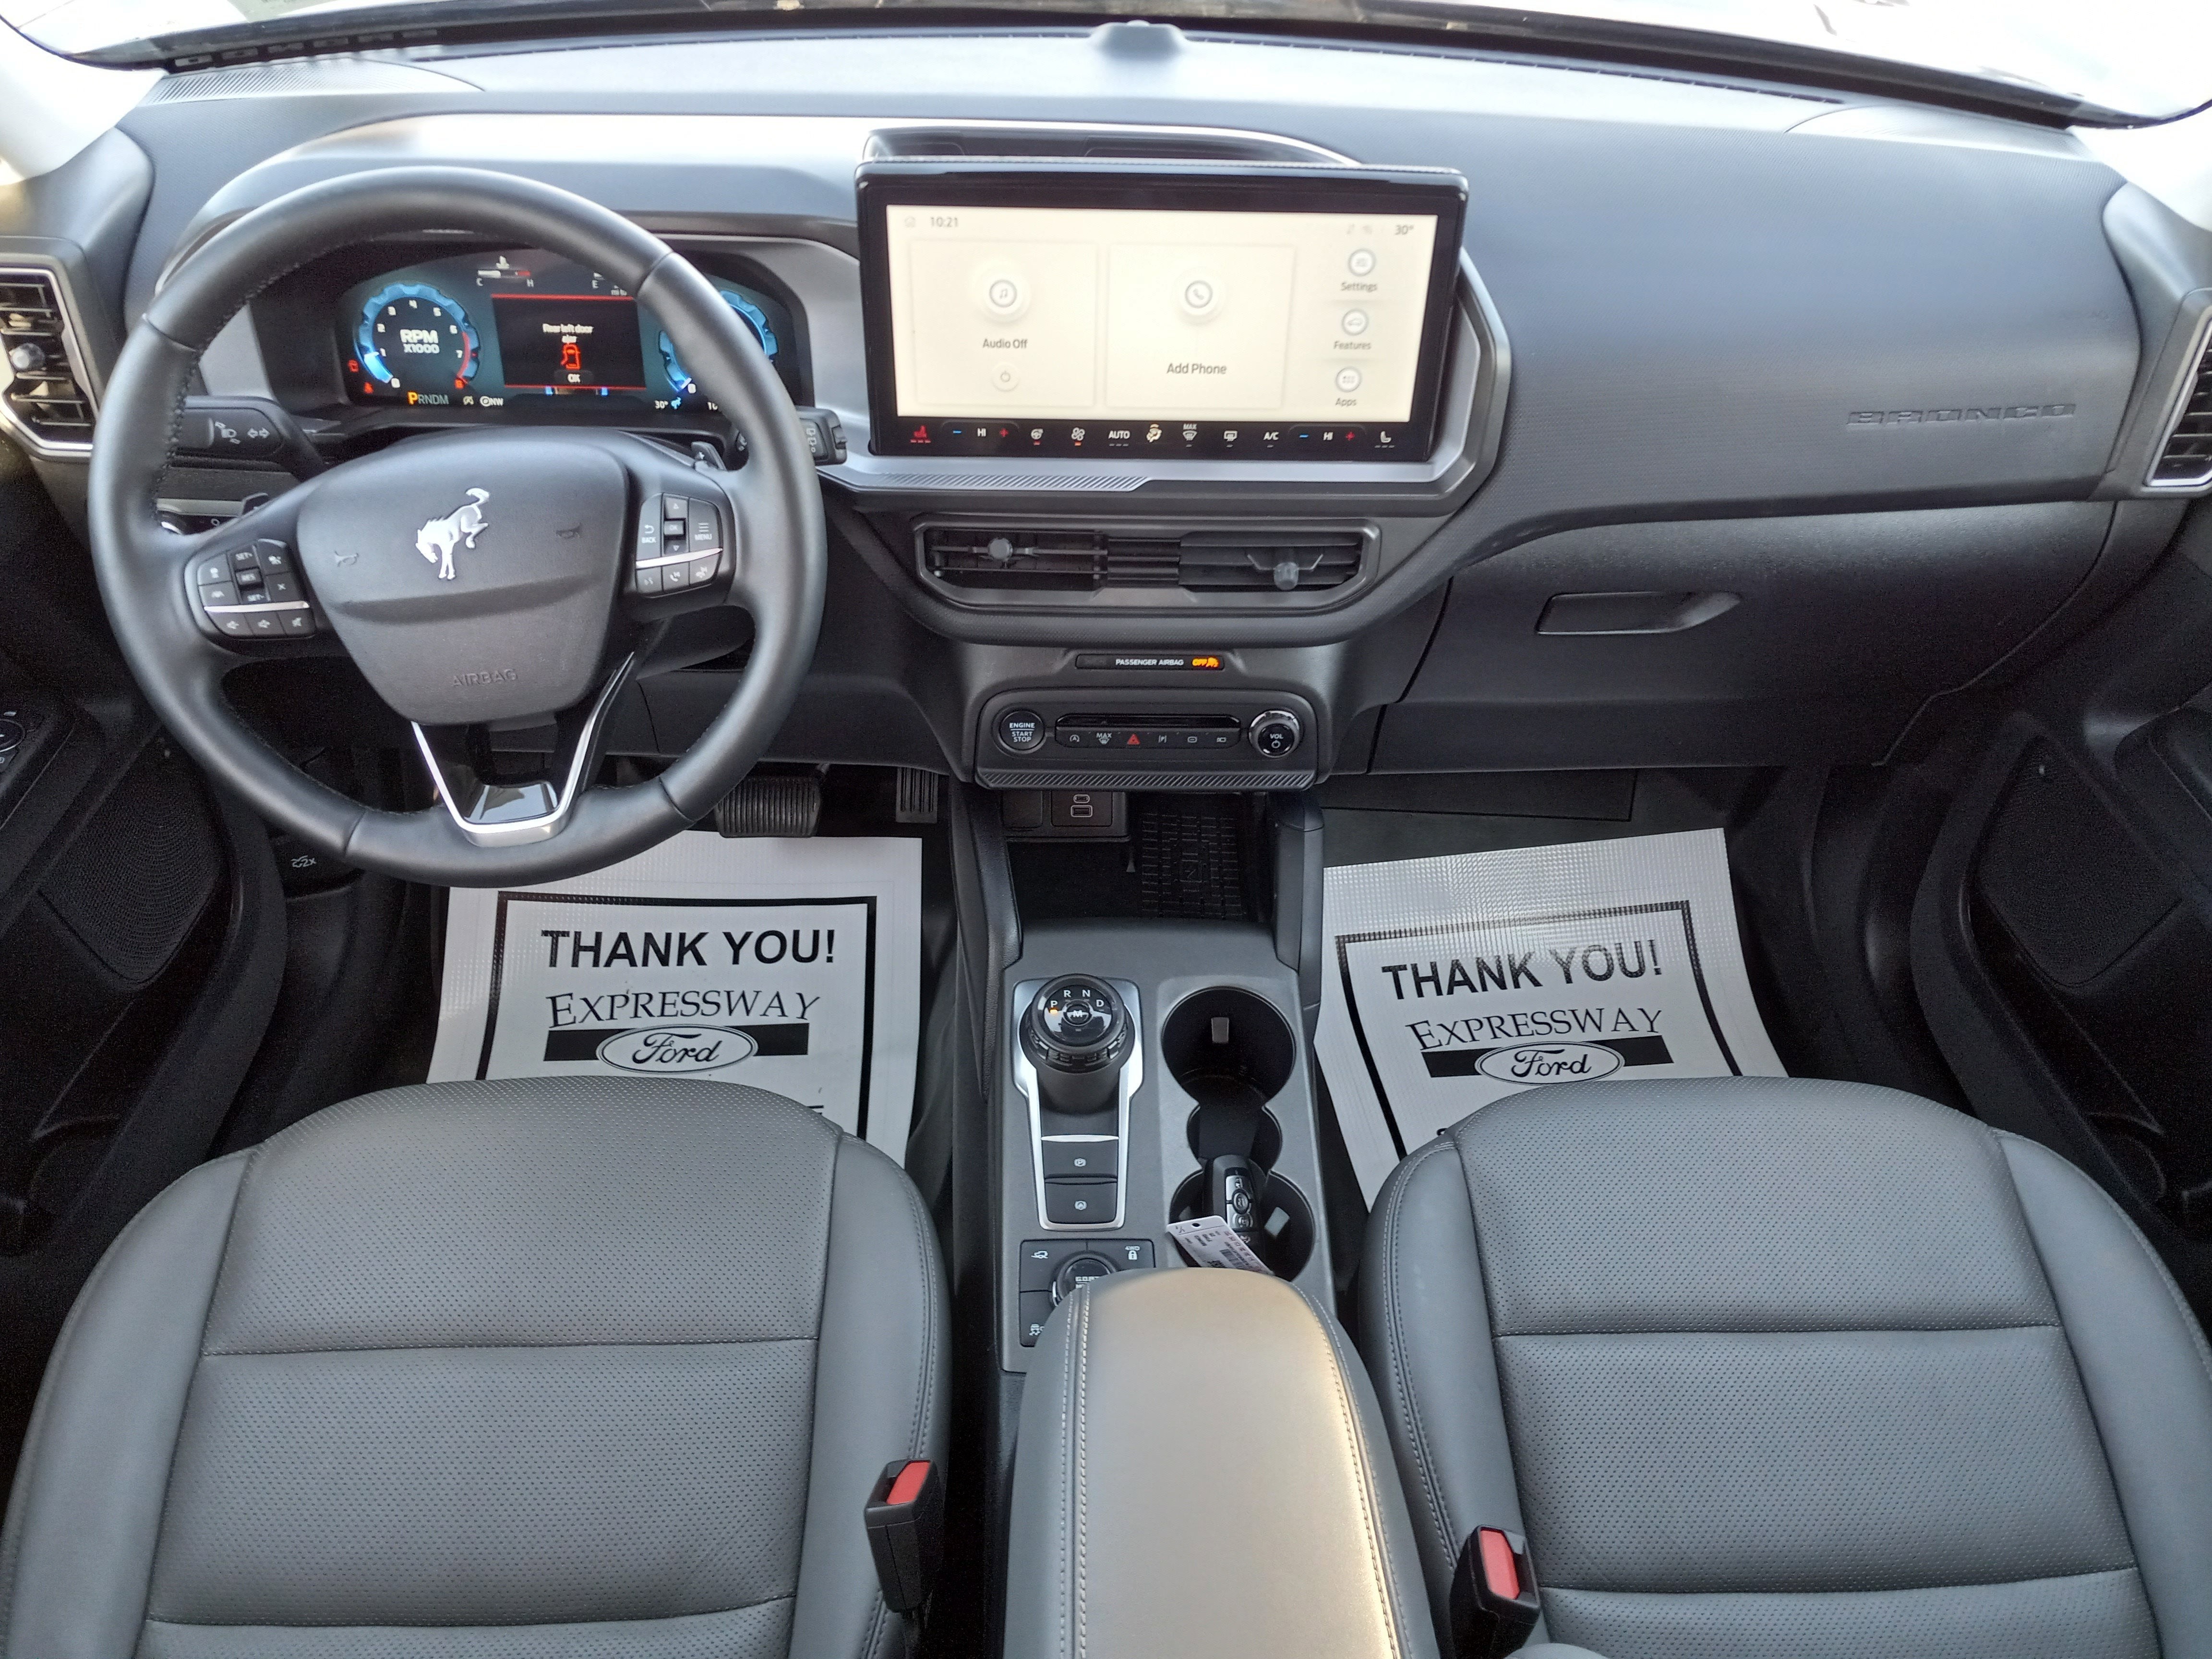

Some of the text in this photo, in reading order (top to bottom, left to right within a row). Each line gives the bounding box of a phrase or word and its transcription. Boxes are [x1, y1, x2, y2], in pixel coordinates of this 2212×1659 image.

[929, 217, 958, 227] 10:21
[1341, 282, 1378, 292] Settings
[400, 329, 439, 343] RPM
[983, 338, 1028, 349] Audio Off
[1334, 341, 1371, 349] Features
[1166, 363, 1227, 374] Add Phone
[1335, 398, 1357, 407] Apps
[977, 428, 986, 437] HI
[1109, 431, 1130, 439] AUTO
[453, 669, 518, 687] AIRBAG
[541, 928, 836, 969] THANK YOU!
[1381, 939, 1662, 1001] THANK YOU!
[546, 989, 821, 1029] EXPRESSWAY
[1405, 1007, 1663, 1051] EXPRESSWAY
[632, 1032, 724, 1065] Ford
[1510, 1048, 1593, 1079] Ford
